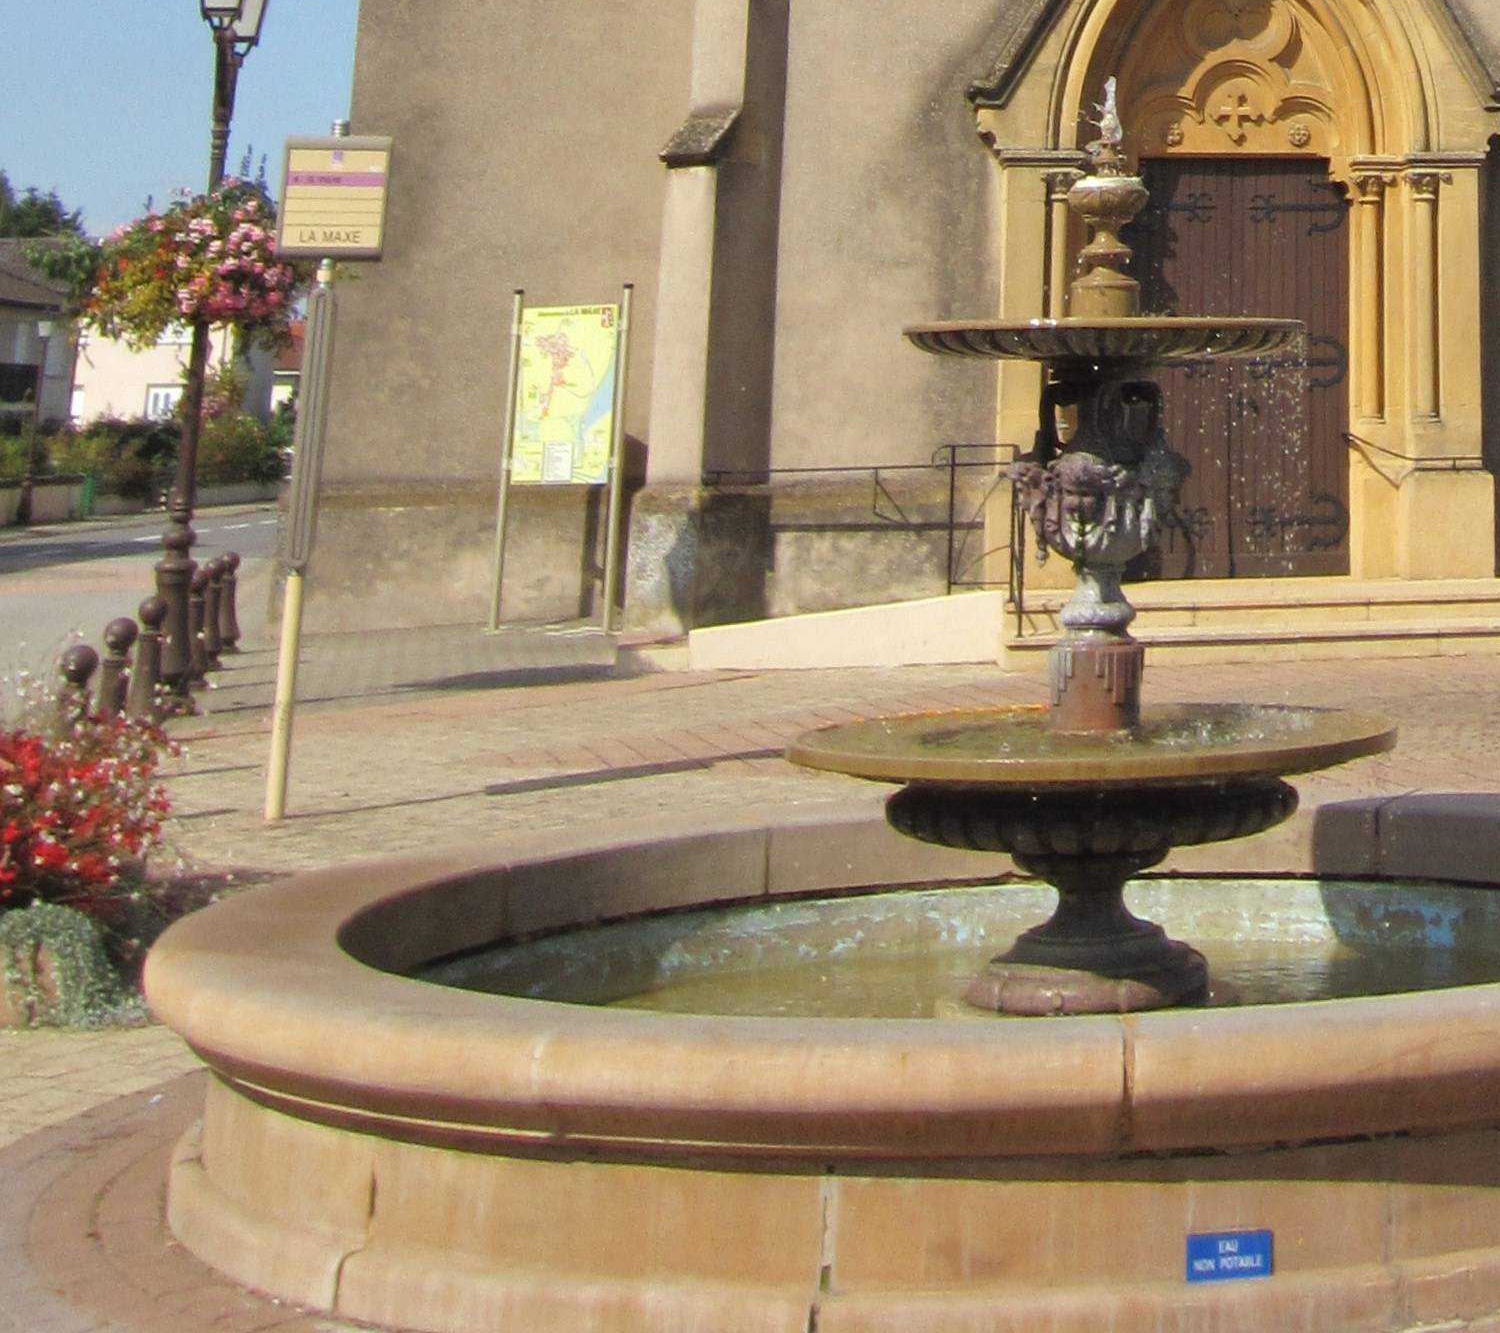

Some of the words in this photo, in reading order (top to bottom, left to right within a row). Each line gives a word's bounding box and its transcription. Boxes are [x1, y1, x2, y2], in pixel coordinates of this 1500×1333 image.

[299, 230, 317, 243] LA
[321, 230, 361, 244] MAXE
[1218, 1239, 1239, 1253] EAU
[1193, 1257, 1216, 1272] NON
[1219, 1253, 1263, 1270] POTABLE
